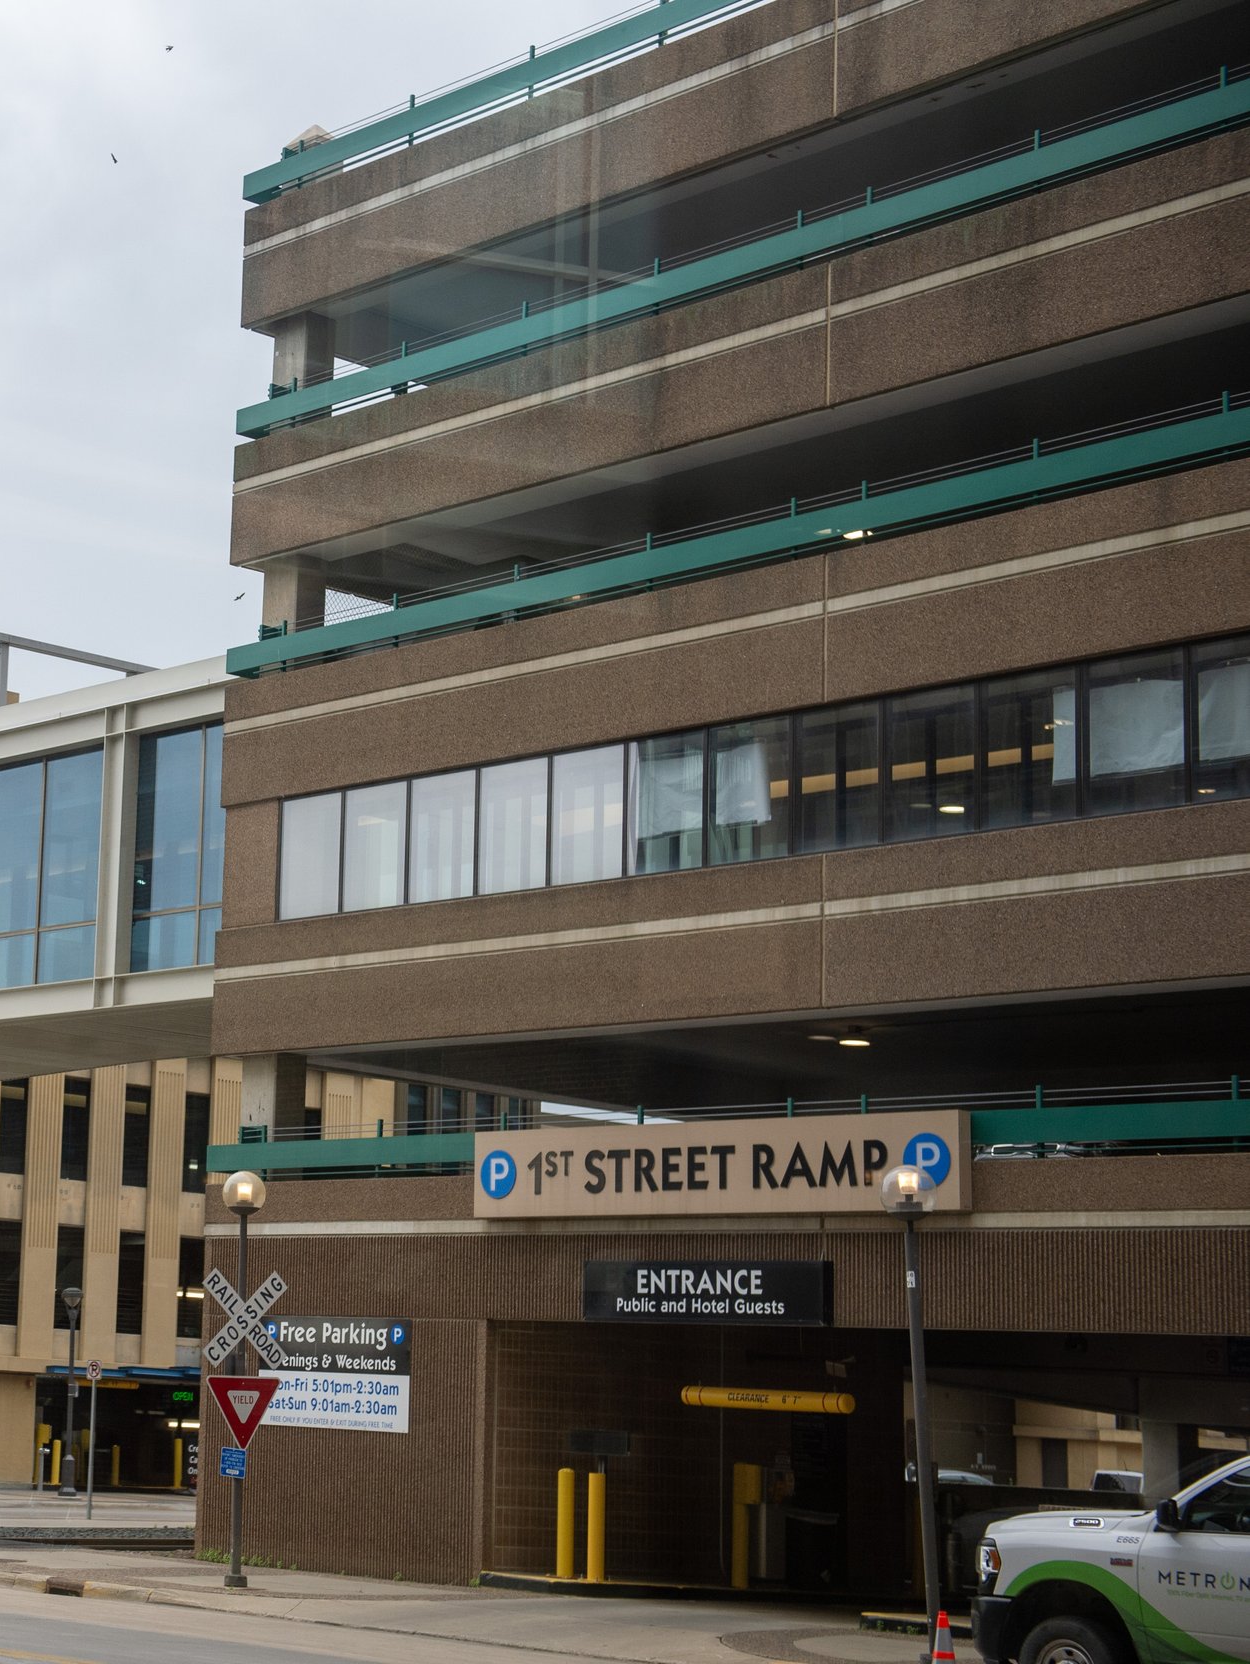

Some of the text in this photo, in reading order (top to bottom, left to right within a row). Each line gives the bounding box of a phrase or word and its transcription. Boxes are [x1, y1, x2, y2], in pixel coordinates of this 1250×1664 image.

[490, 1139, 940, 1195] P 1ST STREET RAMP P
[637, 1269, 763, 1295] ENTRANCE
[616, 1297, 785, 1315] Public and Hotel Guests
[207, 1273, 281, 1364] RAIL ROAD
[208, 1277, 283, 1361] CROSSING
[280, 1322, 317, 1343] Free
[322, 1323, 388, 1350] Parking
[394, 1328, 402, 1342] P
[282, 1353, 396, 1371] enings & Weekends
[172, 1391, 193, 1401] OPEN
[278, 1378, 399, 1396] on-Fri 5:01pm-2:30am
[232, 1395, 254, 1405] YIELD
[311, 1398, 397, 1416] 9:01am-2:30am
[727, 1392, 770, 1404] CLEARANCE
[270, 1415, 281, 1423] FREE
[302, 1417, 312, 1425] YOU
